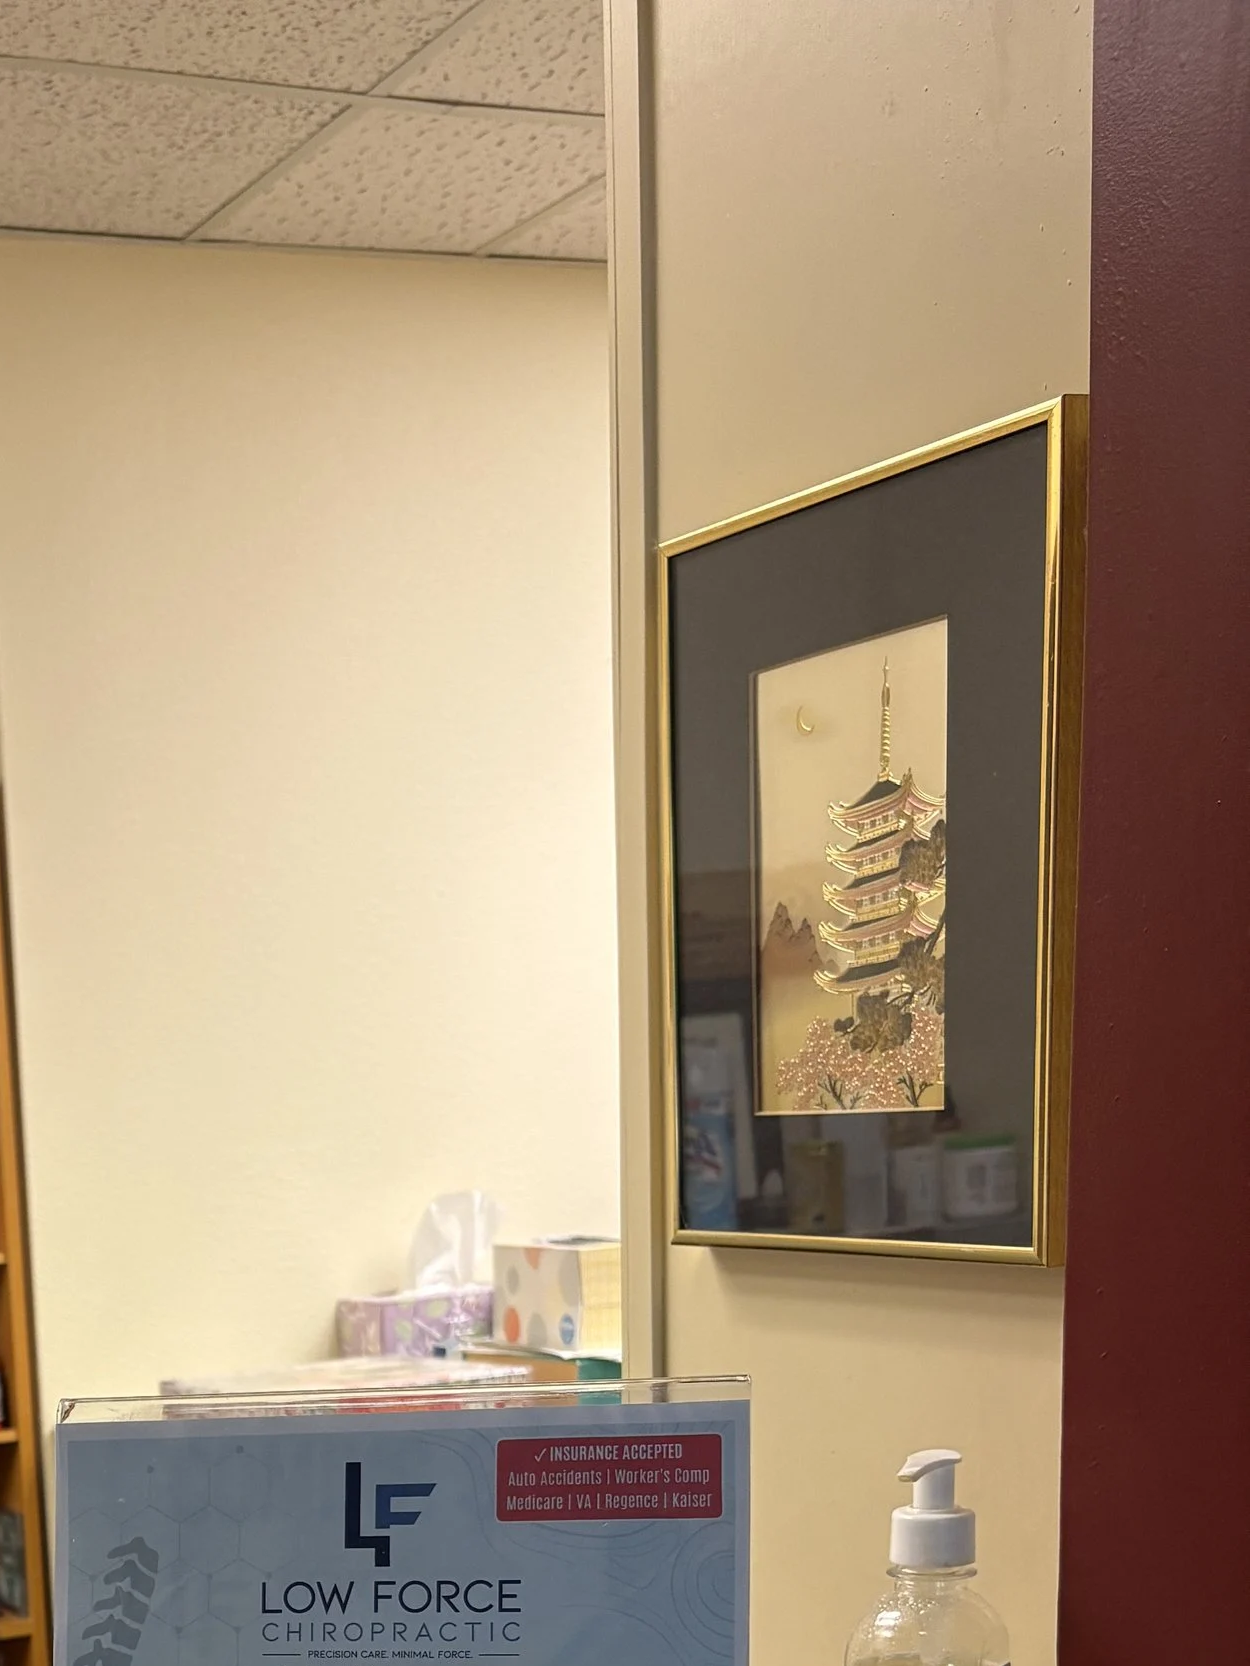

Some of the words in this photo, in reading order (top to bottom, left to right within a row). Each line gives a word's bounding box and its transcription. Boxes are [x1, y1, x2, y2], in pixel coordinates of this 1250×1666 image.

[550, 1445, 619, 1461] INSURANCE
[622, 1443, 683, 1460] ACCEPTED
[508, 1471, 536, 1486] Auto
[541, 1470, 602, 1485] Accidents
[615, 1469, 670, 1484] Worker's
[675, 1468, 709, 1485] Comp
[507, 1495, 563, 1511] Medicare
[576, 1494, 591, 1509] VA
[605, 1493, 658, 1509] Regence
[672, 1493, 712, 1507] Kaiser
[261, 1581, 355, 1615] LOW
[374, 1579, 522, 1613] FORCE
[262, 1622, 521, 1642] CHIROPRACTIC
[307, 1651, 358, 1659] PRECISION
[360, 1651, 389, 1659] CARE.
[392, 1651, 434, 1659] MINIMAL
[438, 1651, 473, 1659] FORCE.
